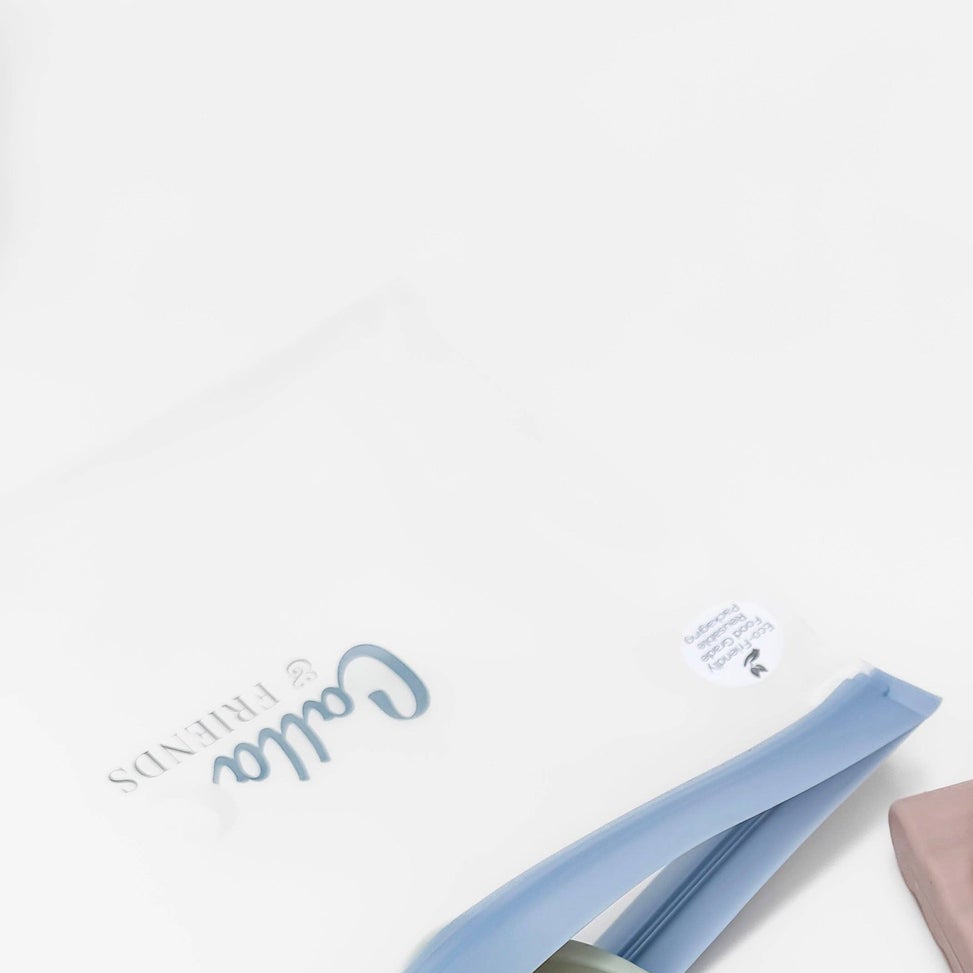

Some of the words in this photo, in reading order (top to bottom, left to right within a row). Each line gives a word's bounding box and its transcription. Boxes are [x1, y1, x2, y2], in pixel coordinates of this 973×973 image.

[697, 613, 747, 649] Reusable
[733, 616, 762, 638] Food
[701, 637, 735, 662] Grade
[708, 622, 775, 672] Eco-Friendly
[286, 658, 318, 687] &
[212, 643, 431, 784] Calla
[108, 682, 280, 794] FRIENDS
